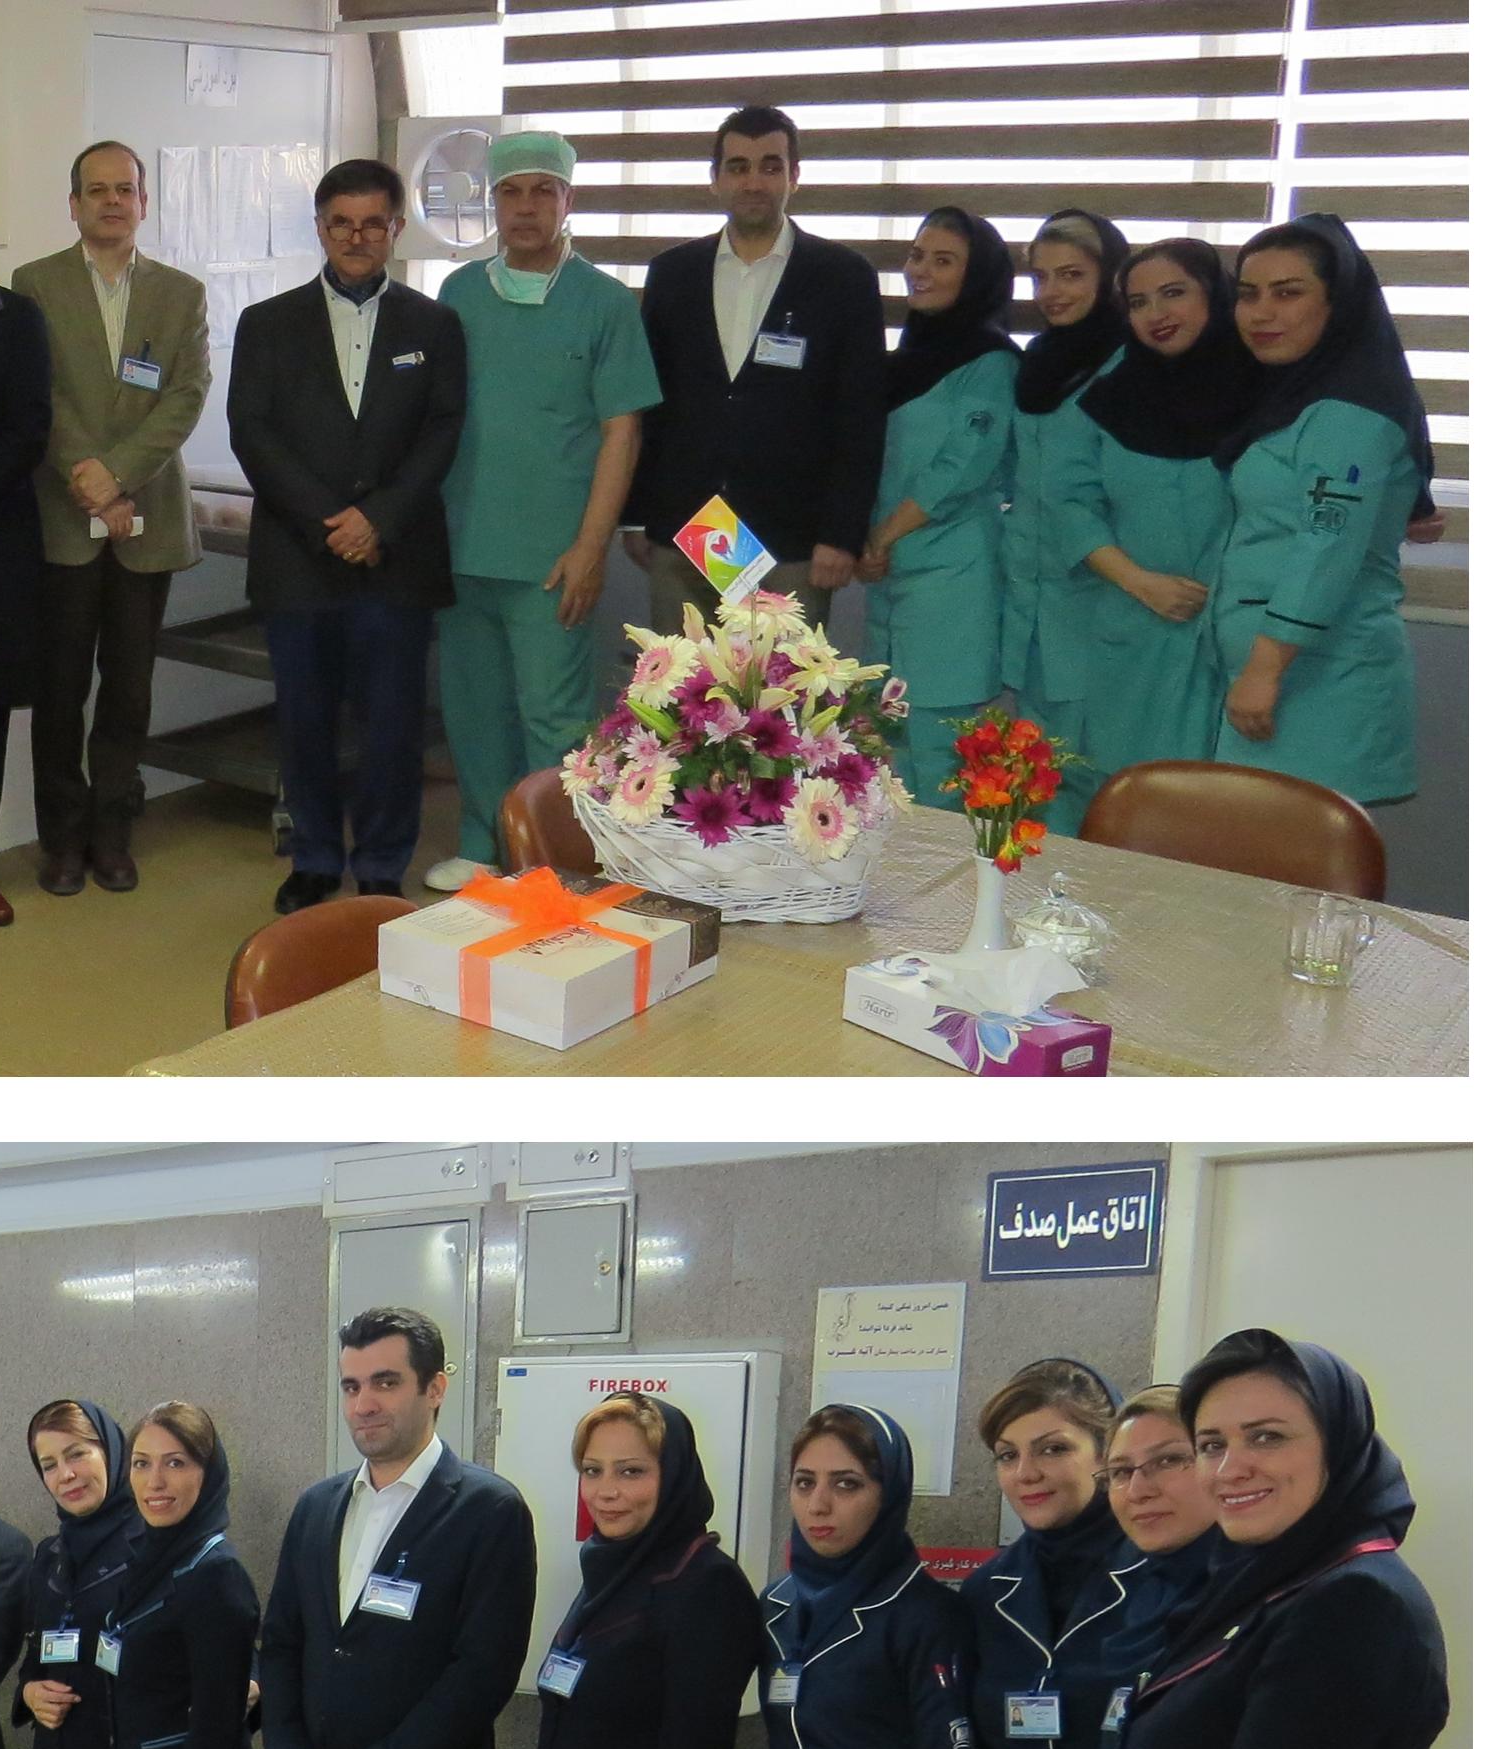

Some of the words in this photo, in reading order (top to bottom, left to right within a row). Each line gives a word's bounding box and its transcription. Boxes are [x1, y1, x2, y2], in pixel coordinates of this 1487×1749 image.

[998, 1202, 1057, 1240] صدف
[1057, 1201, 1100, 1249] عمل
[1102, 1195, 1147, 1241] اتاق
[589, 1379, 667, 1393] FIREBOX
